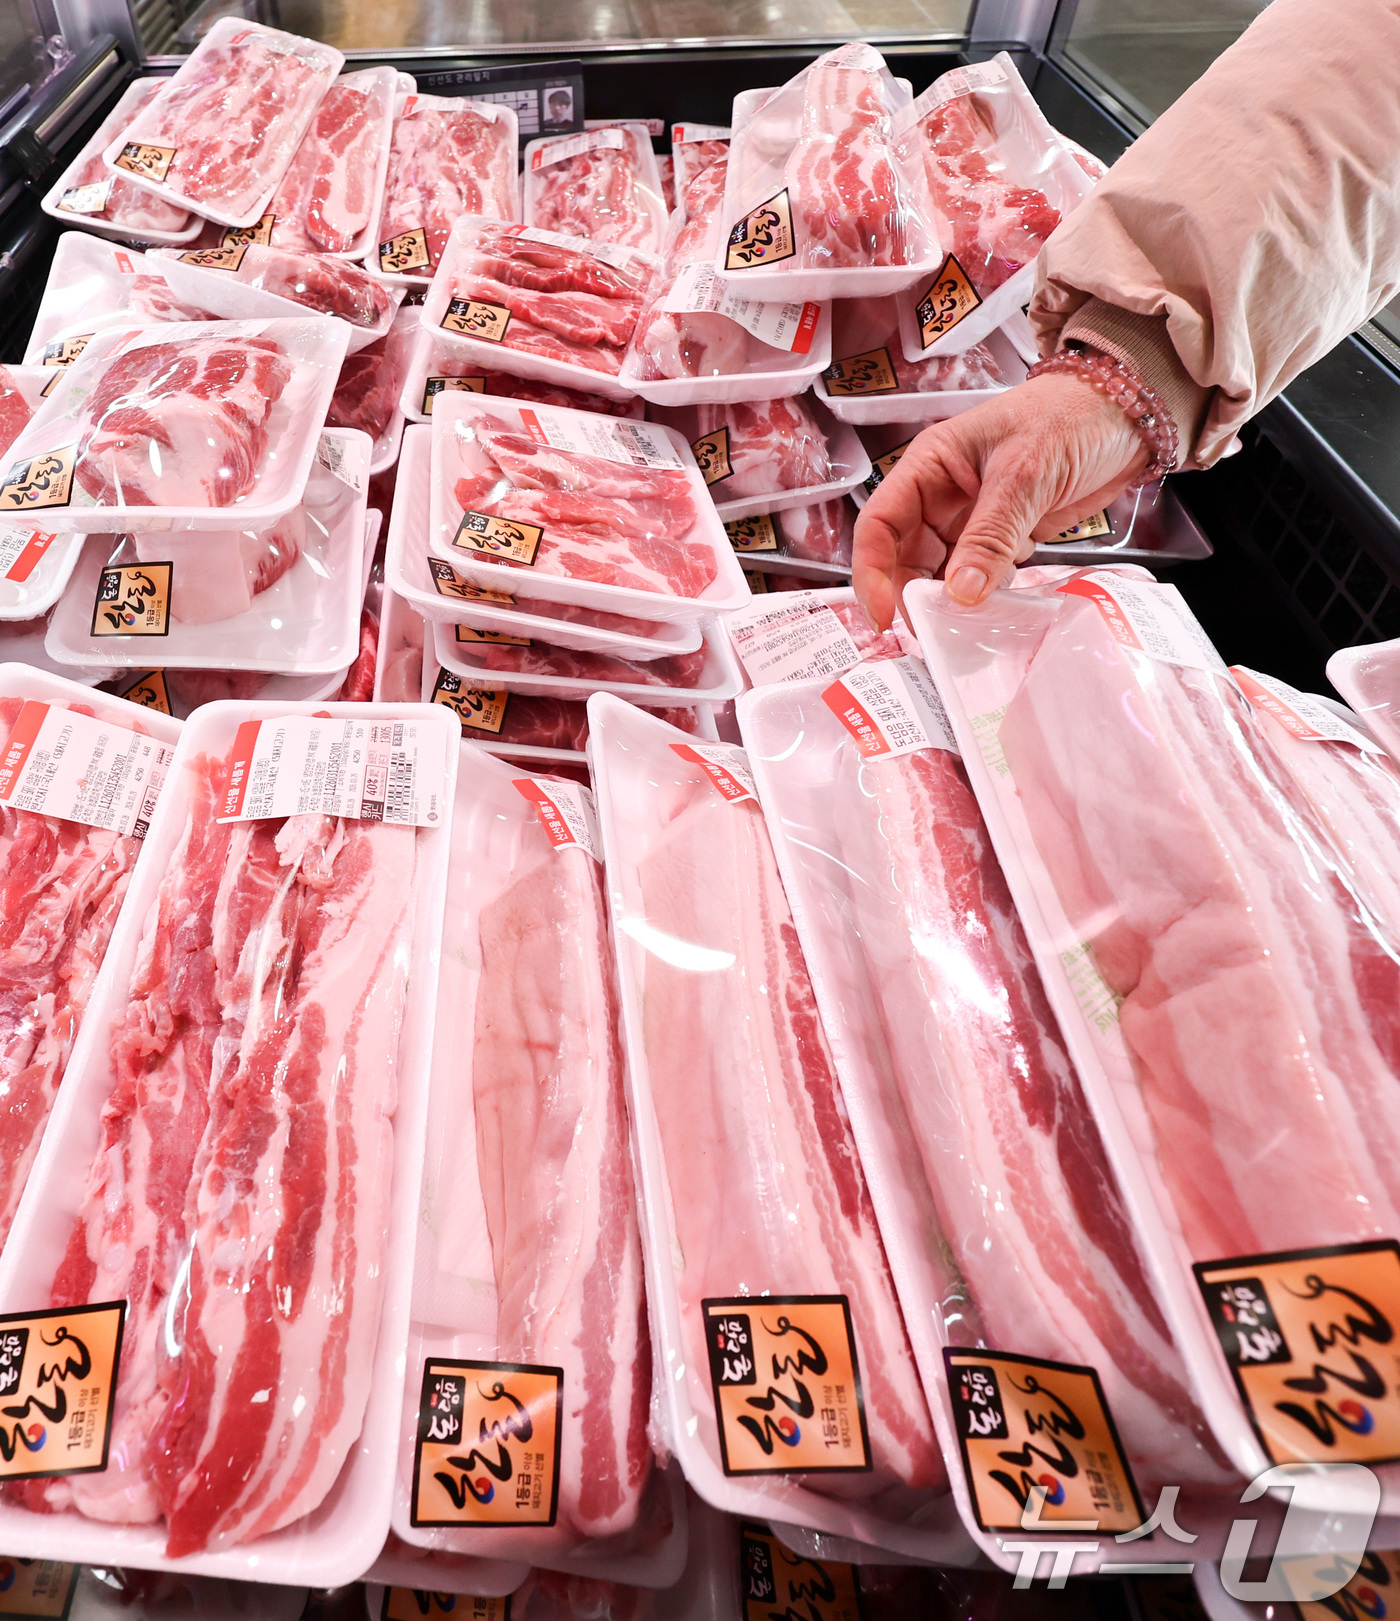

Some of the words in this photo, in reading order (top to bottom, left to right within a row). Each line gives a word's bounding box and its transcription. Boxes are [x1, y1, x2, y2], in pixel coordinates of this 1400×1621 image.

[736, 209, 781, 262] 한돈
[452, 305, 497, 330] 한돈
[929, 279, 958, 332] 한돈
[8, 457, 63, 505] 한돈
[468, 520, 524, 550] 한돈
[104, 571, 156, 628] 한돈
[146, 609, 155, 626] 1등급
[843, 707, 862, 726] 새롭게
[875, 705, 896, 722] 돼지
[271, 728, 285, 761] (돼지고기)
[379, 726, 392, 742] 13005
[857, 724, 881, 752] 신선을
[882, 720, 916, 747] 돈담음
[4, 742, 25, 768] 새롭게
[352, 750, 360, 763] 4250
[133, 767, 144, 781] 4250
[228, 760, 246, 785] 새롭게
[365, 778, 379, 795] 40%
[140, 799, 156, 817] 40%
[222, 788, 240, 813] 신선을
[360, 802, 371, 818] 행사
[369, 802, 383, 819] 카드
[548, 820, 568, 841] 신선을
[1221, 1285, 1282, 1360] 돈담음
[719, 1317, 752, 1382] 돈담음
[1273, 1274, 1395, 1447] 한돈
[0, 1327, 91, 1462] 한돈
[89, 1386, 100, 1411] 선별
[736, 1316, 828, 1455] 한돈
[834, 1384, 847, 1404] 선별
[429, 1381, 460, 1439] 돈담음
[962, 1369, 1001, 1436] 돈담음
[67, 1411, 80, 1451] 1등급
[78, 1388, 87, 1409] 이상
[83, 1412, 97, 1449] 돼지고기
[822, 1407, 840, 1449] 1등급
[837, 1407, 851, 1449] 돼지고기
[434, 1381, 533, 1510] 한돈
[987, 1370, 1085, 1512] 한돈
[523, 1451, 533, 1471] 이상
[534, 1452, 545, 1472] 선별
[516, 1472, 531, 1509] 1등급
[532, 1473, 542, 1509] 돼지고기
[1086, 1469, 1110, 1510] 1등급
